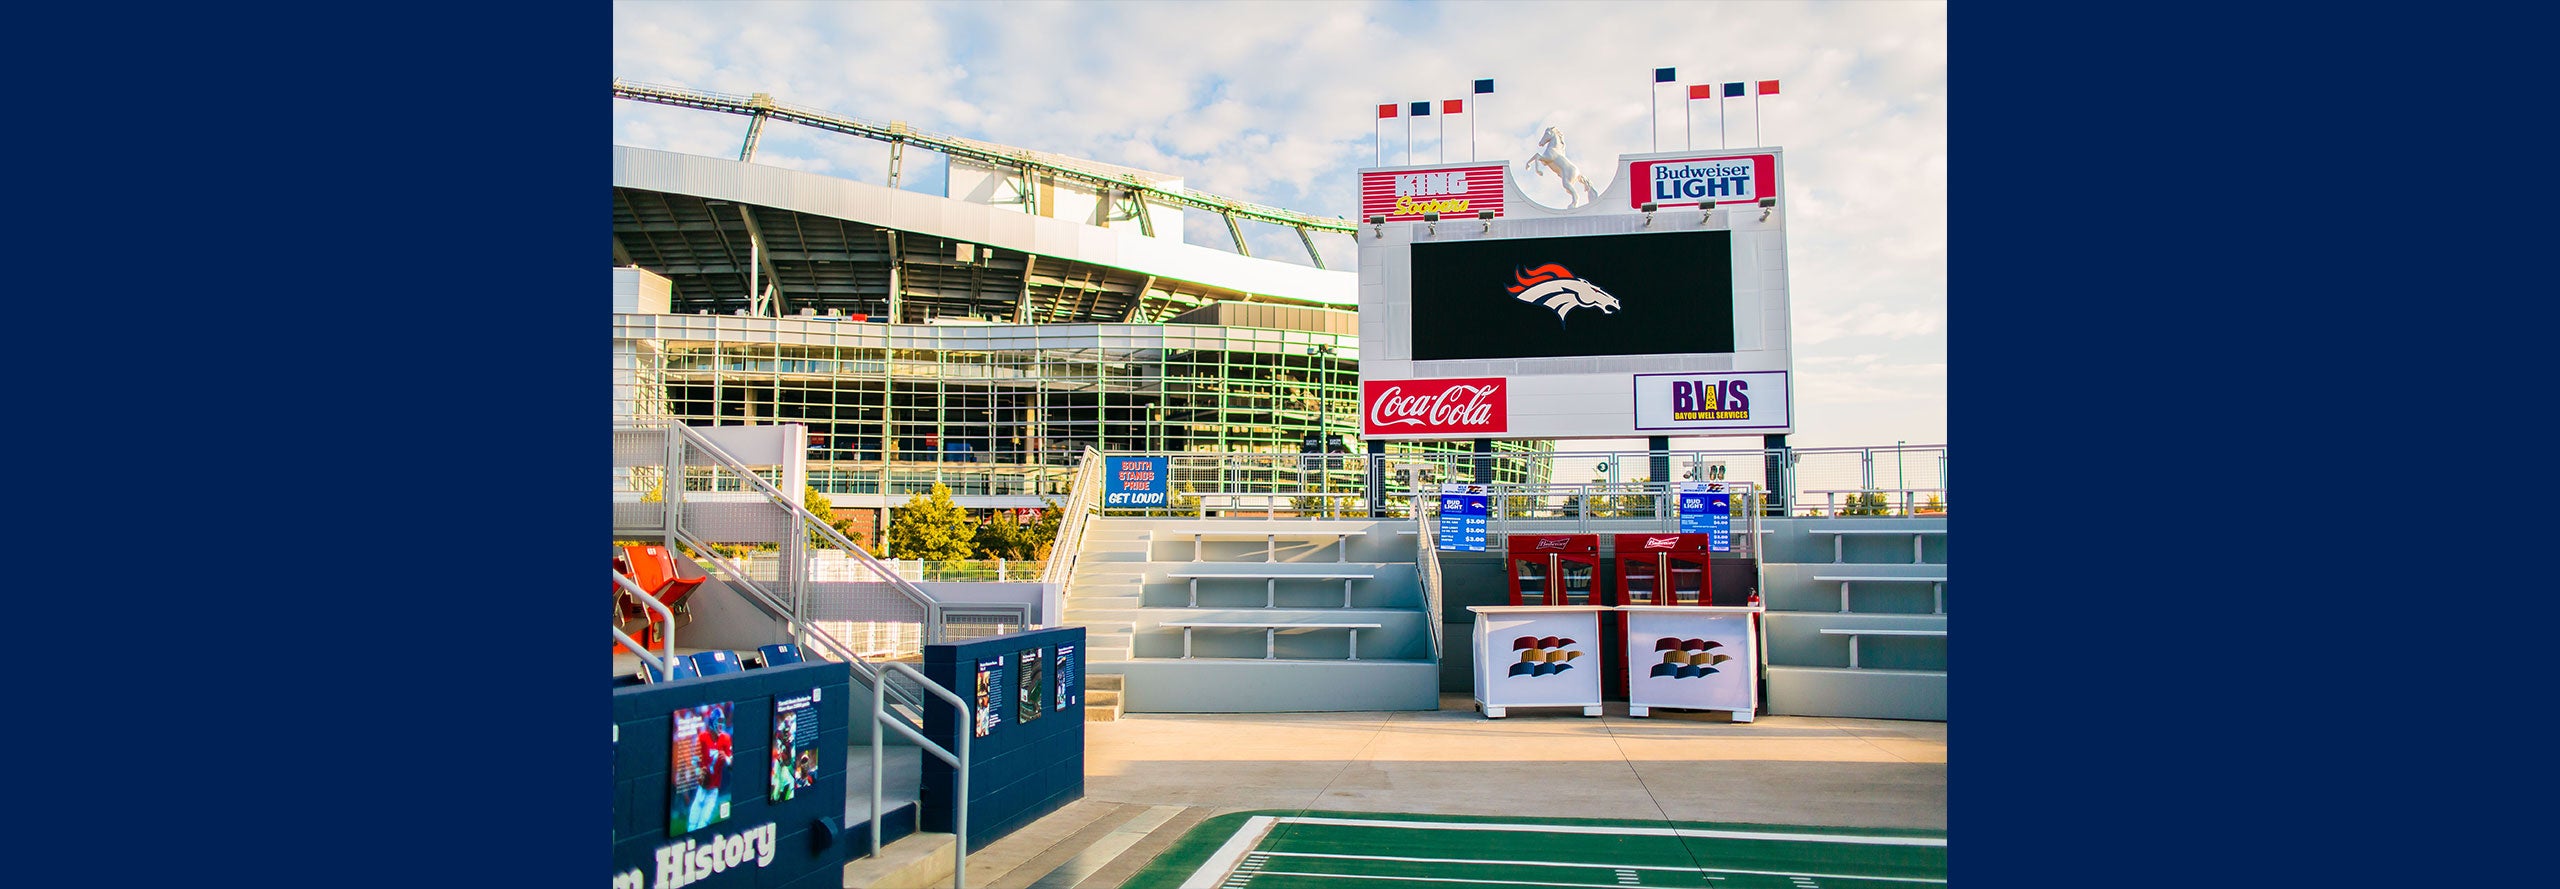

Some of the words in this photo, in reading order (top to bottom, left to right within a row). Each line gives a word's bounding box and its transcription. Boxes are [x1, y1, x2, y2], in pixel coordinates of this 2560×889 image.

[1655, 163, 1750, 180] Budweiser
[1395, 172, 1468, 197] KING
[1656, 176, 1750, 199] LIGHT
[1393, 196, 1470, 215] Soopers
[1371, 385, 1500, 426] Coca-Cola
[1673, 380, 1749, 412] BWS
[1675, 412, 1697, 420] BAYOU
[1697, 411, 1715, 419] WELL
[1716, 411, 1748, 419] SERVICES
[1121, 461, 1152, 471] SOUTH
[1119, 471, 1155, 481] STANDS
[1123, 481, 1150, 491] PRIDE
[1108, 492, 1130, 504] GET
[1131, 492, 1164, 504] LOUD!
[709, 749, 719, 774] 7
[654, 822, 777, 889] History
